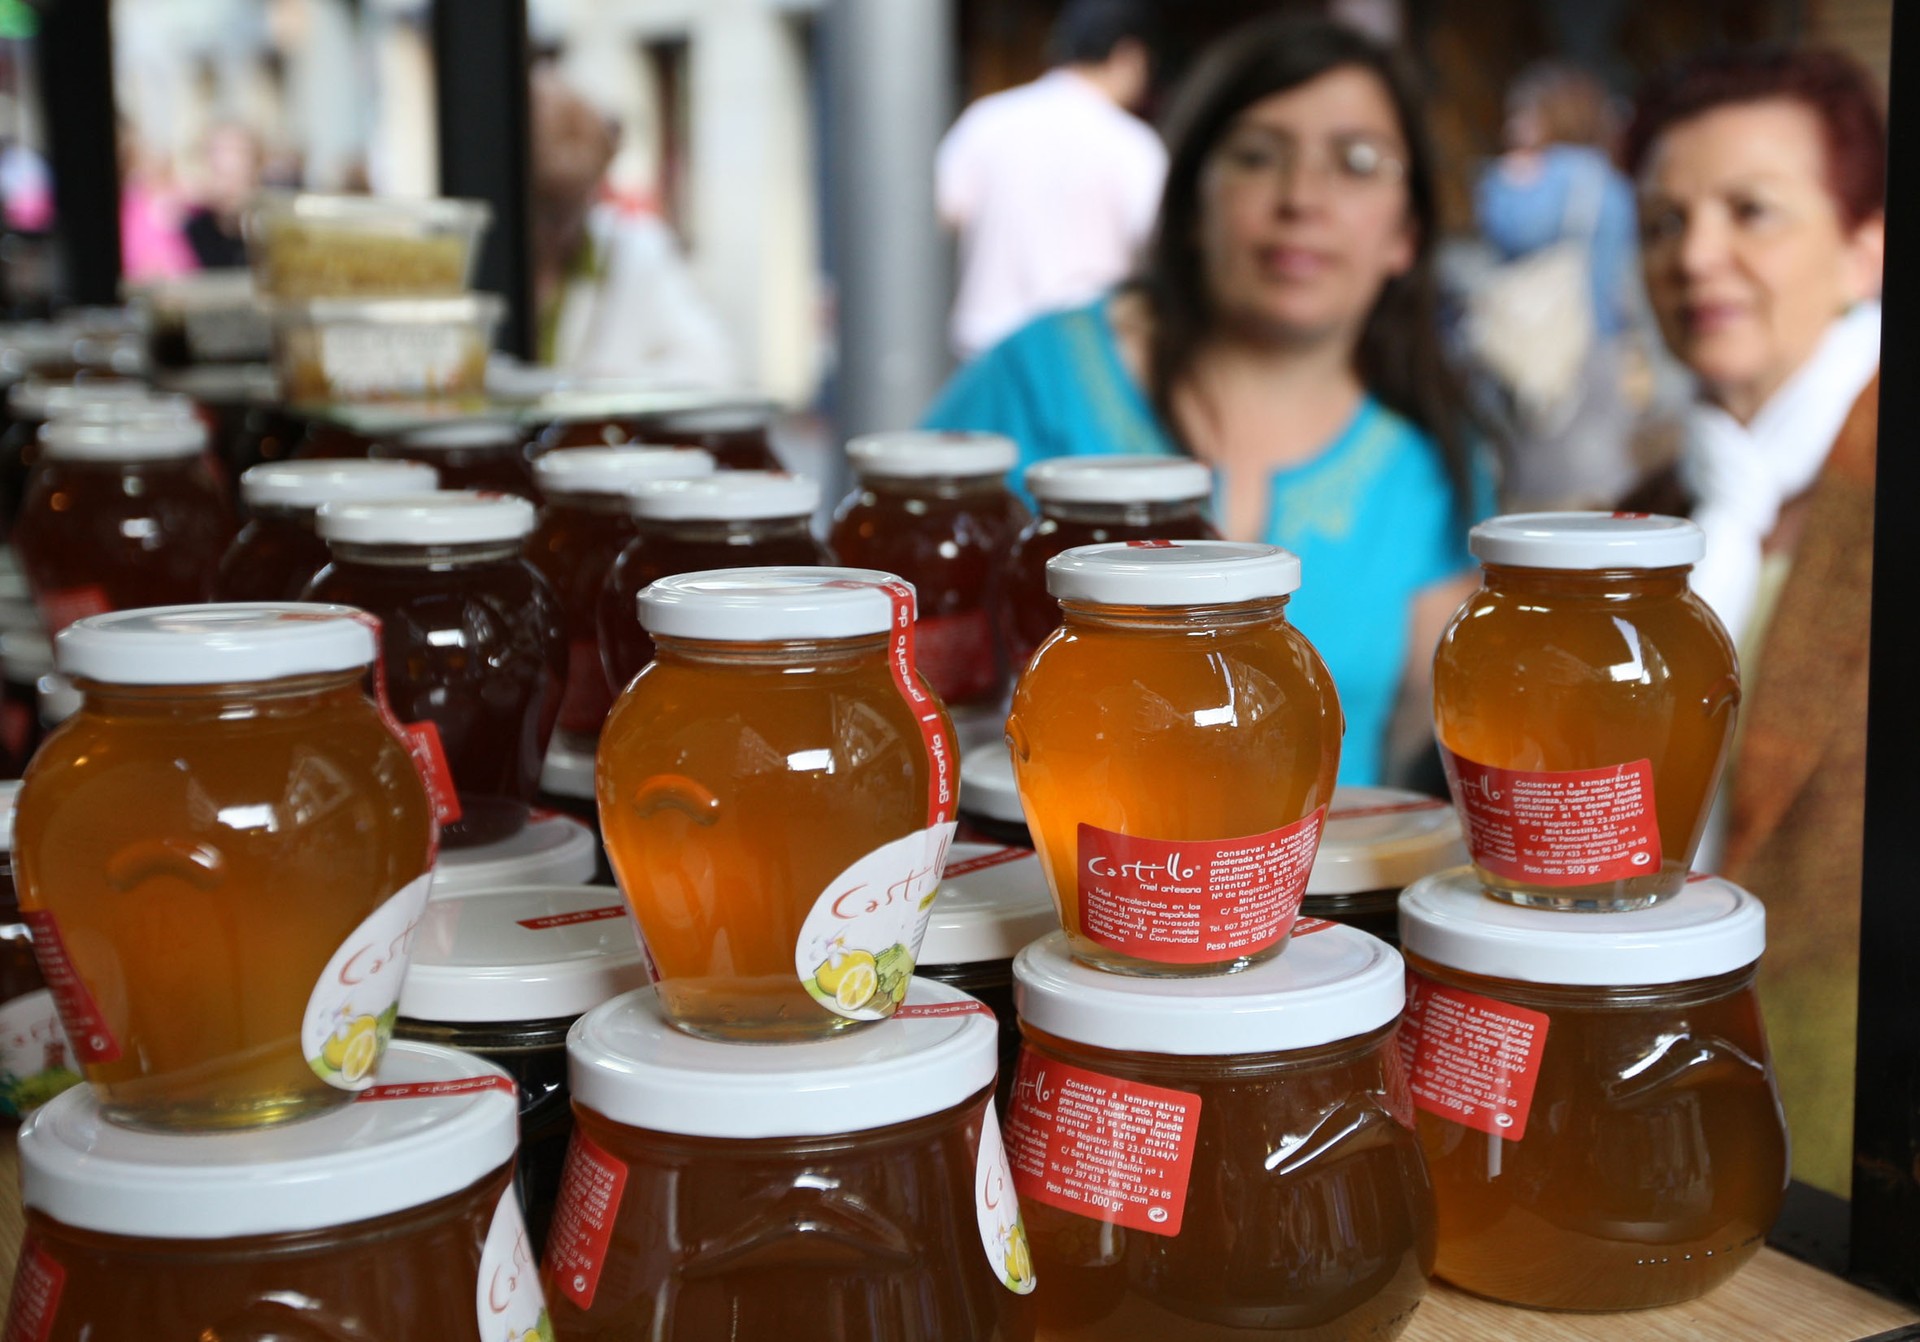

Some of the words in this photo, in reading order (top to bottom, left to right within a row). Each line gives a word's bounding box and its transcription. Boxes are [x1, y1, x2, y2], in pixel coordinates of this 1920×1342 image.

[898, 605, 908, 628] de
[895, 634, 926, 702] precinto
[931, 734, 950, 804] garantía
[1515, 780, 1562, 789] Conservar
[1581, 772, 1640, 787] temperatura
[1598, 792, 1615, 800] miel
[1617, 787, 1641, 798] puede
[1579, 810, 1603, 818] baño
[1210, 857, 1253, 867] moderada
[1267, 846, 1285, 857] lugar
[1216, 845, 1265, 858] Conservar
[1088, 852, 1194, 882] Castillo
[1209, 872, 1254, 883] cristalizar.
[1257, 868, 1265, 876] Si
[1268, 865, 1277, 873] se
[1210, 867, 1229, 876] gran
[1232, 863, 1261, 873] pureza,
[1263, 852, 1289, 866] nuestra
[1567, 865, 1586, 874] 500
[1140, 883, 1158, 891] miel
[1209, 880, 1251, 891] calentar
[1258, 875, 1267, 884] al
[1273, 865, 1292, 879] baño
[1096, 887, 1111, 897] Miel
[1225, 891, 1236, 899] de
[1238, 883, 1272, 897] Registro:
[1239, 895, 1256, 905] Miel
[1088, 899, 1130, 919] Elaborada
[1152, 919, 1200, 927] envasada
[1128, 906, 1156, 916] montes
[1233, 906, 1248, 914] San
[1250, 895, 1277, 910] Pascual
[1119, 928, 1130, 936] en
[1135, 931, 1143, 939] la
[1149, 933, 1199, 943] Comunidad
[1224, 923, 1238, 931] 607
[1240, 920, 1253, 928] 397
[1206, 942, 1226, 951] Peso
[1228, 938, 1249, 948] neto:
[1251, 930, 1267, 943] 500
[1268, 927, 1277, 937] gr.
[338, 920, 420, 985] Cast
[1480, 1009, 1535, 1031] temperatura
[1061, 1088, 1094, 1103] moderada
[1096, 1098, 1106, 1106] en
[1108, 1100, 1129, 1111] lugar
[1131, 1106, 1153, 1117] seco.
[1156, 1110, 1171, 1120] Por
[1173, 1115, 1184, 1123] su
[1066, 1079, 1107, 1096] Conservar
[1124, 1093, 1186, 1114] temperatura
[1058, 1106, 1093, 1122] cristalizar.
[1096, 1116, 1105, 1125] Si
[1108, 1120, 1118, 1128] se
[1120, 1122, 1146, 1135] desea
[1150, 1128, 1181, 1141] líquida
[1059, 1098, 1074, 1106] gran
[1075, 1102, 1101, 1116] pureza,
[1103, 1109, 1133, 1122] nuestra
[1135, 1117, 1153, 1126] miel
[1155, 1122, 1183, 1132] puede
[1056, 1116, 1089, 1130] calentar
[1096, 1126, 1105, 1134] al
[1112, 1129, 1137, 1142] baño
[1145, 1138, 1179, 1151] maría.
[1066, 1129, 1076, 1137] de
[1077, 1131, 1110, 1147] Registro:
[1113, 1140, 1125, 1150] RS
[1127, 1144, 1179, 1161] 23.03144/V
[1061, 1146, 1070, 1155] C/
[1070, 1149, 1084, 1159] San
[1086, 1154, 1115, 1167] Pascual
[1117, 1162, 1143, 1174] Bailón
[1158, 1170, 1164, 1178] 1
[1076, 1141, 1093, 1152] Miel
[1094, 1146, 1128, 1162] Castillo,
[1130, 1155, 1146, 1165] S.L.
[1051, 1162, 1060, 1172] Tel.
[1062, 1166, 1073, 1175] 607
[1074, 1170, 1087, 1179] 397
[1088, 1174, 1101, 1183] 433
[1108, 1180, 1120, 1188] Fax
[1122, 1182, 1131, 1191] 96
[1134, 1185, 1148, 1194] 137
[1149, 1189, 1159, 1197] 26
[1161, 1191, 1172, 1200] 05
[1076, 1160, 1141, 1183] Paterna-Valencia
[1046, 1181, 1061, 1194] Peso
[1063, 1188, 1081, 1200] neto:
[1084, 1192, 1110, 1208] 1.000
[1112, 1201, 1124, 1212] gr.
[1065, 1178, 1148, 1205] www.mielcastillo.com
[489, 1227, 529, 1314] Cast
